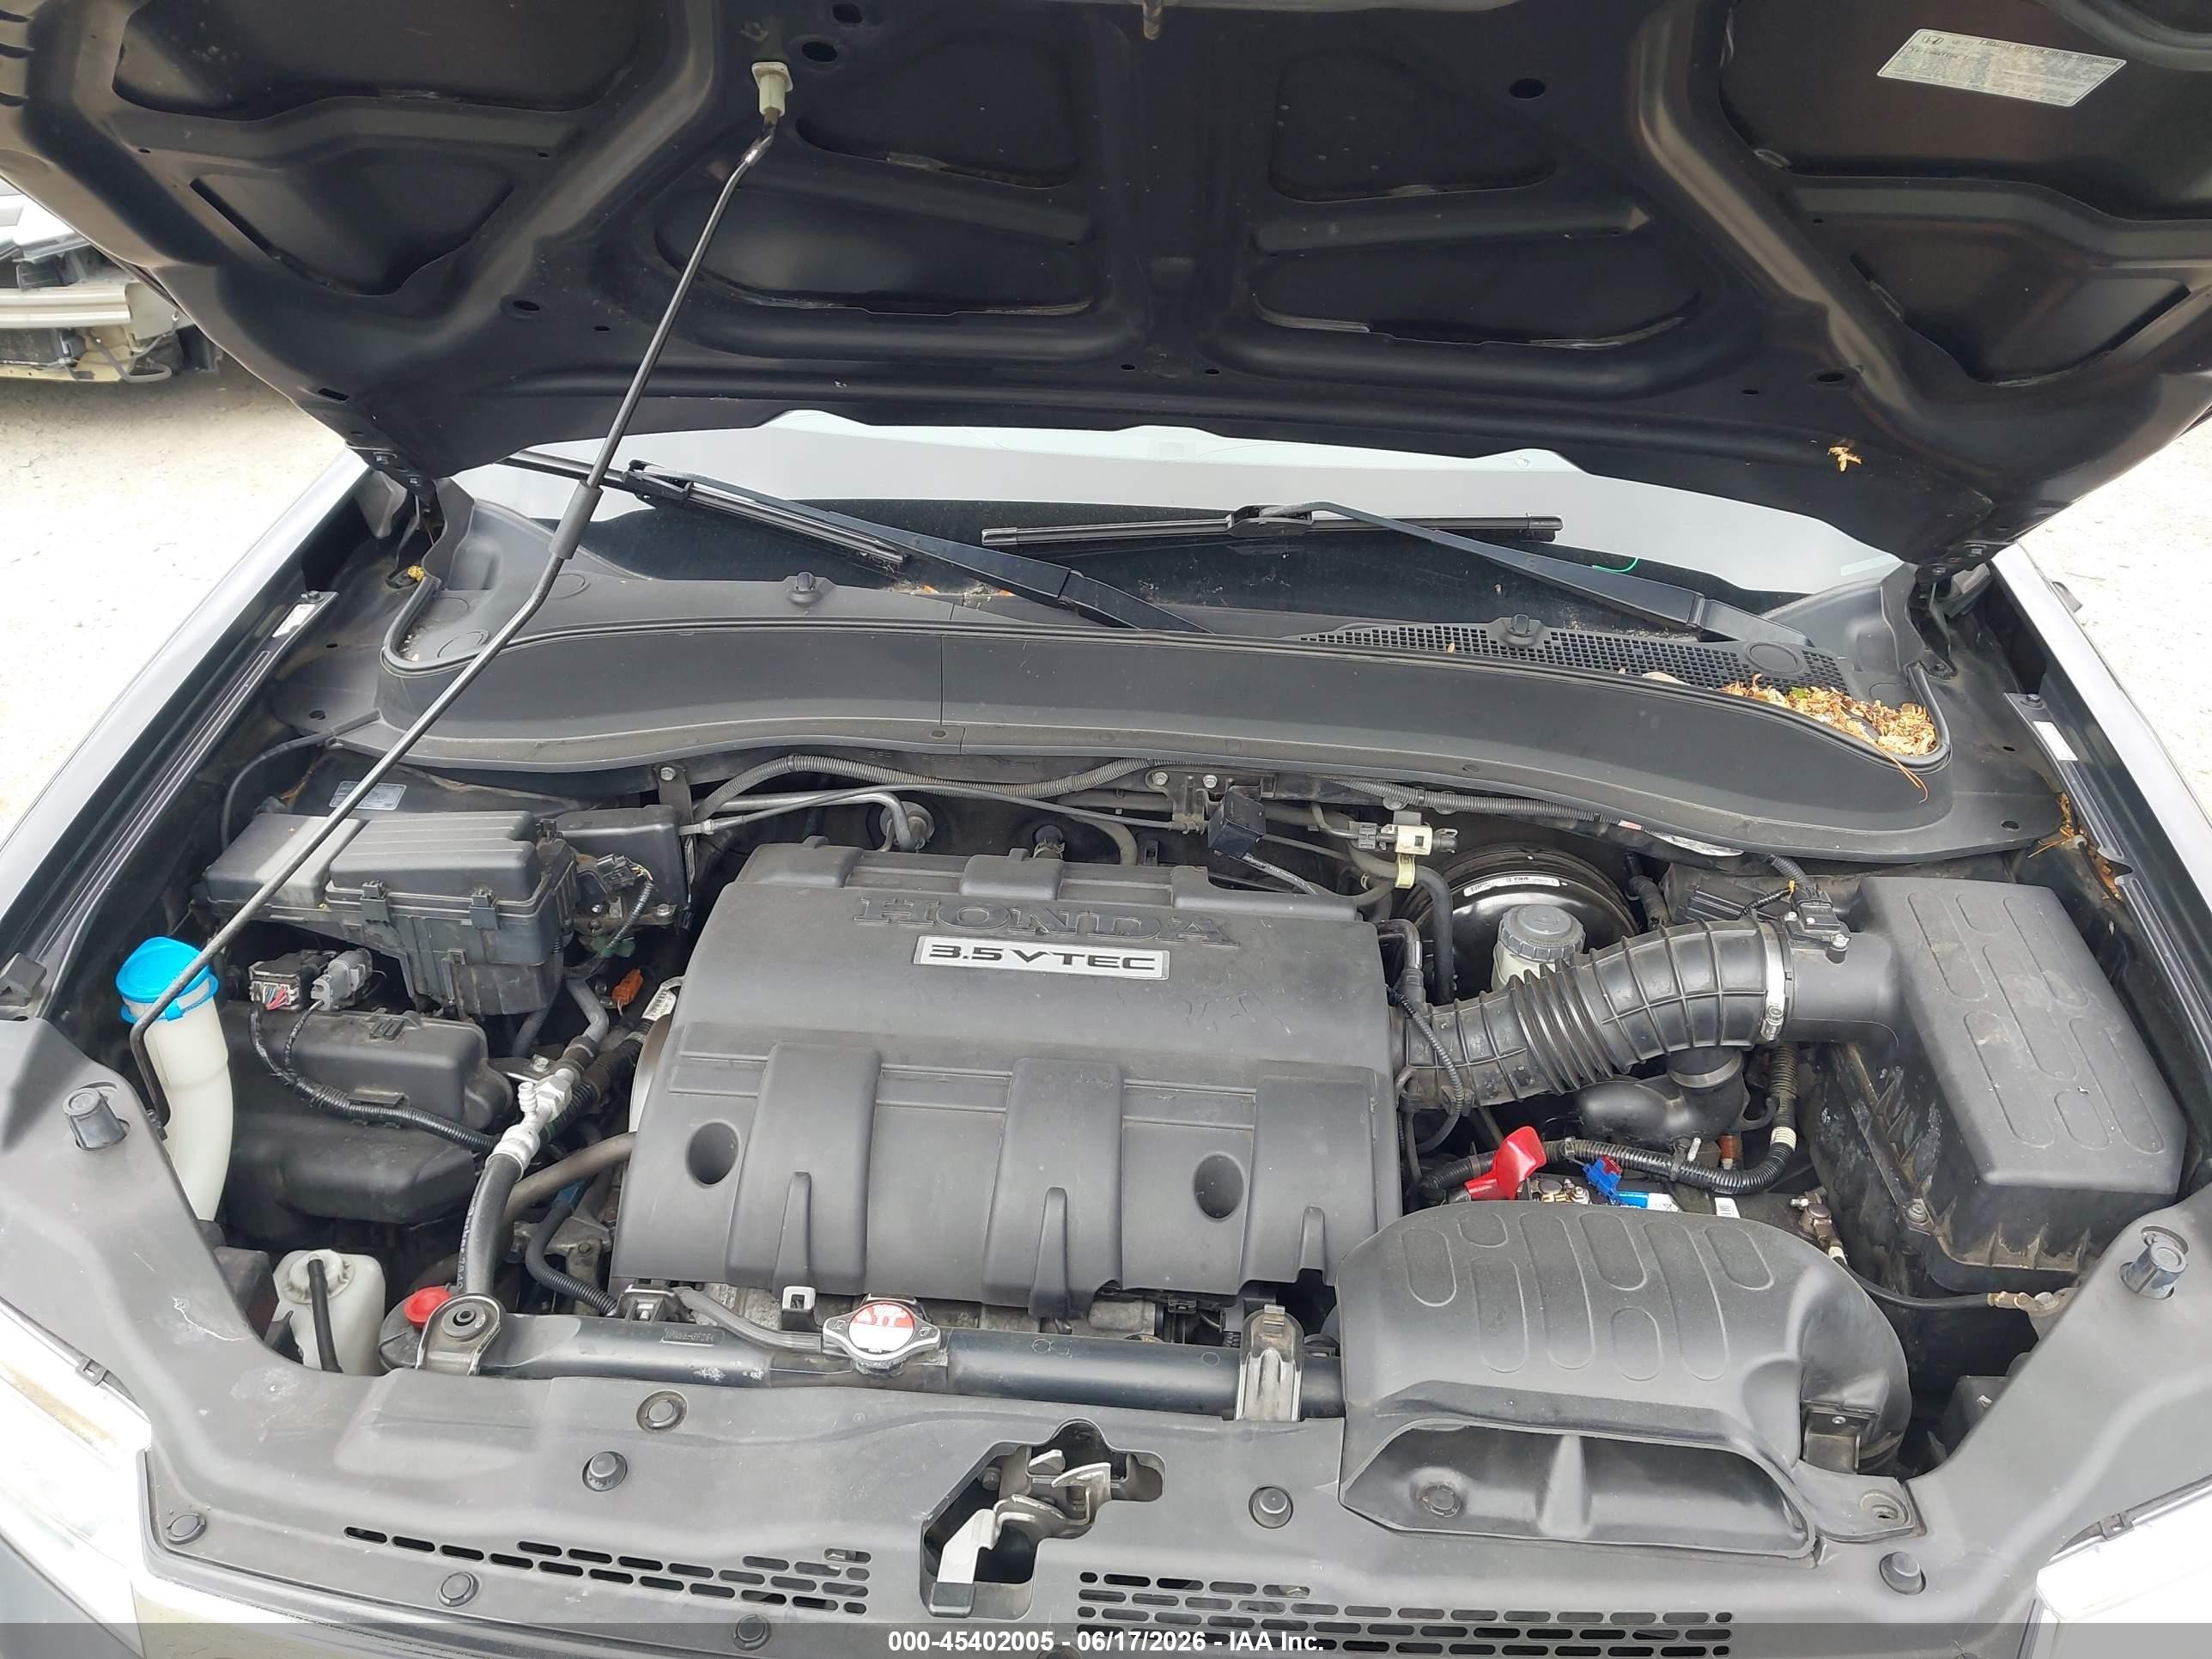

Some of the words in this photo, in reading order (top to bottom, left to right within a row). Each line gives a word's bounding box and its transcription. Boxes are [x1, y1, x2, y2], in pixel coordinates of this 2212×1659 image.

[854, 896, 1241, 948] HONDA
[928, 944, 1004, 962] 3.5
[1010, 948, 1156, 971] VTEC
